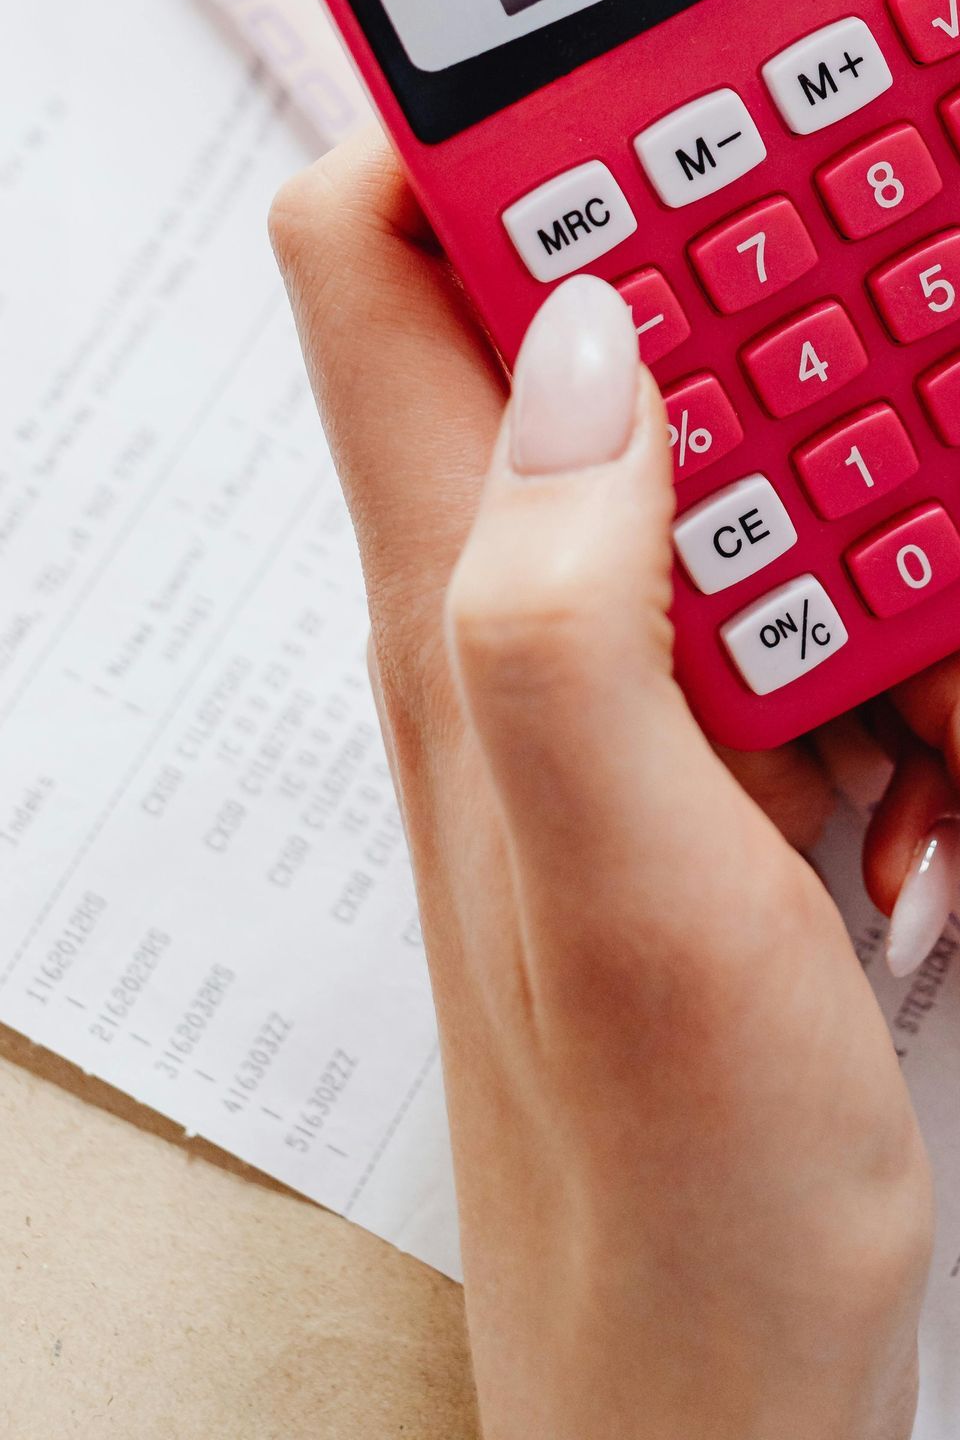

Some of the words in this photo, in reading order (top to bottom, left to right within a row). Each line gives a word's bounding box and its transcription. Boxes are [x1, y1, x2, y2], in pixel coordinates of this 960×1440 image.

[797, 51, 864, 106] M+
[866, 160, 905, 209] 8
[536, 197, 611, 256] MRC
[736, 231, 768, 283] 7
[918, 263, 956, 313] 5
[798, 340, 829, 382] 4
[844, 445, 875, 488] 1
[712, 507, 771, 559] CE
